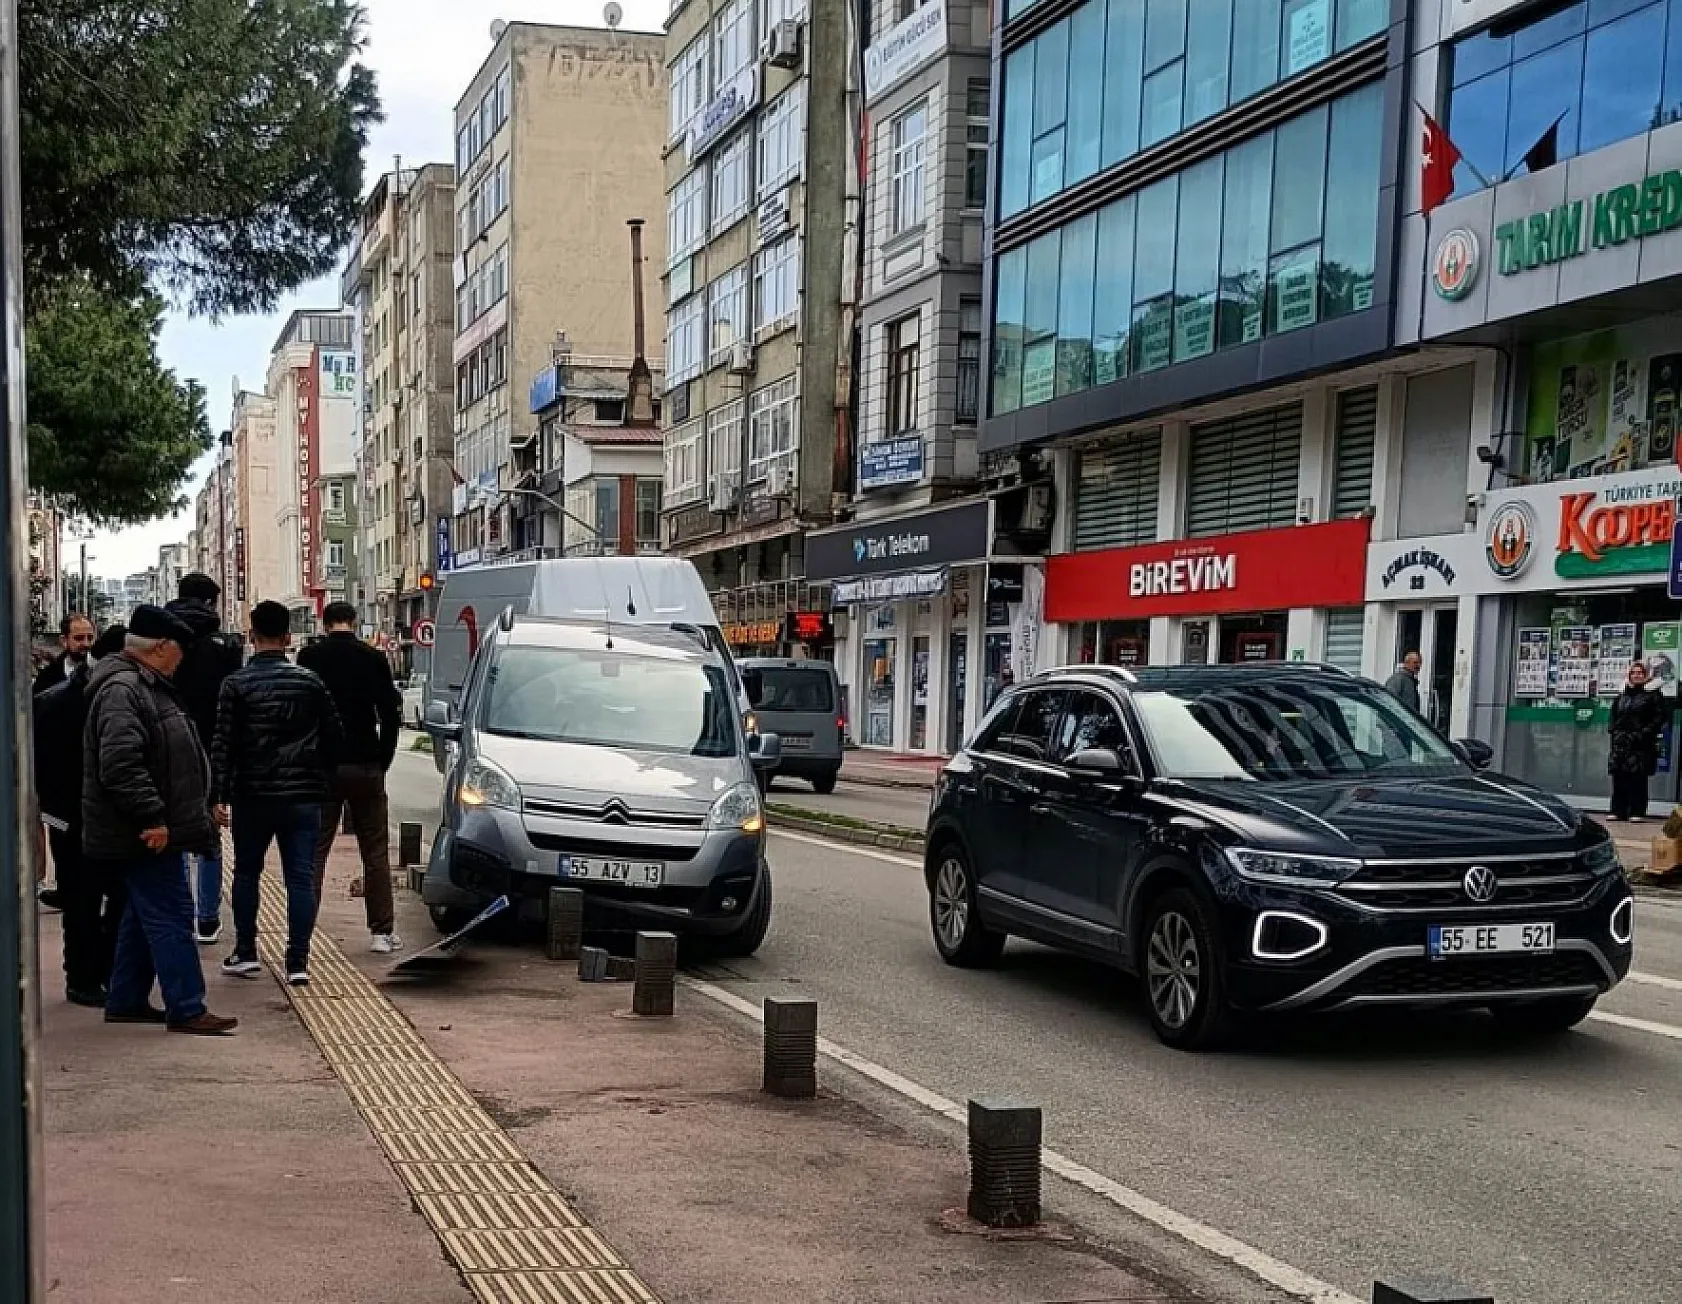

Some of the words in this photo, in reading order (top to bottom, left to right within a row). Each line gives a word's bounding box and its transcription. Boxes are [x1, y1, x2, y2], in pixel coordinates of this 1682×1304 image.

[1496, 201, 1586, 276] TARIM
[1603, 483, 1653, 504] TÜRKİYE
[301, 516, 313, 588] HOTEL
[866, 536, 887, 560] Türk
[888, 531, 930, 557] Telekom
[571, 858, 589, 876] 55
[602, 861, 631, 880] AZV
[644, 866, 660, 883] 13
[1441, 928, 1465, 951] 55
[1476, 927, 1499, 950] EE
[1521, 924, 1553, 948] 521
